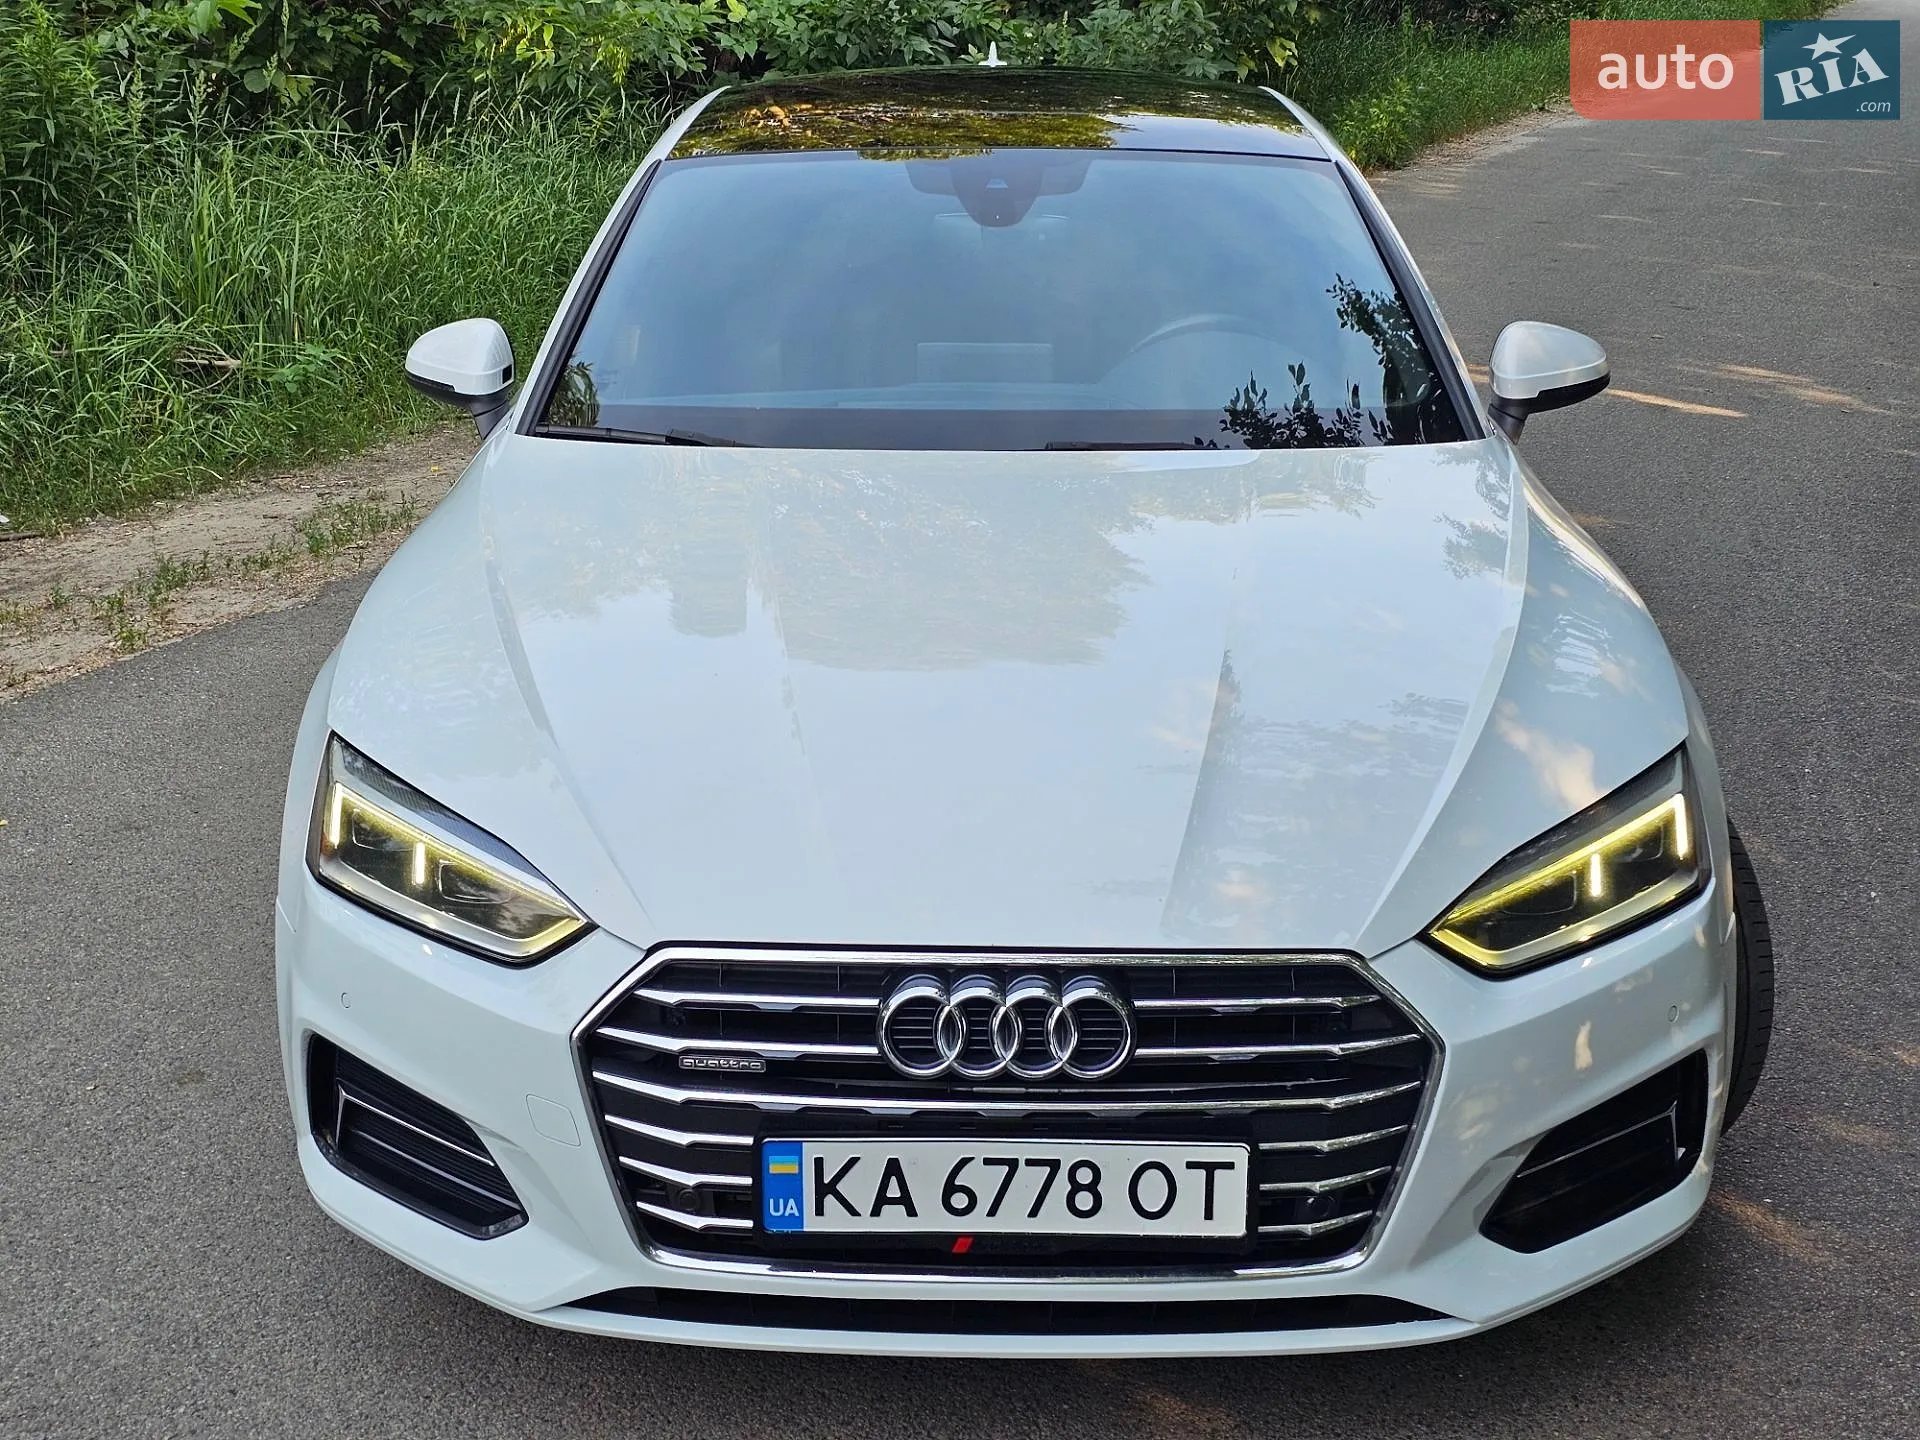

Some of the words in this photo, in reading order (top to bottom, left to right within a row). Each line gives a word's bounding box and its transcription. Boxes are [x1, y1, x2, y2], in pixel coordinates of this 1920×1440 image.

[682, 1058, 762, 1069] quattro
[812, 1156, 919, 1218] KA
[940, 1156, 1103, 1219] 6778
[1127, 1160, 1236, 1221] OT
[769, 1198, 800, 1217] UA
